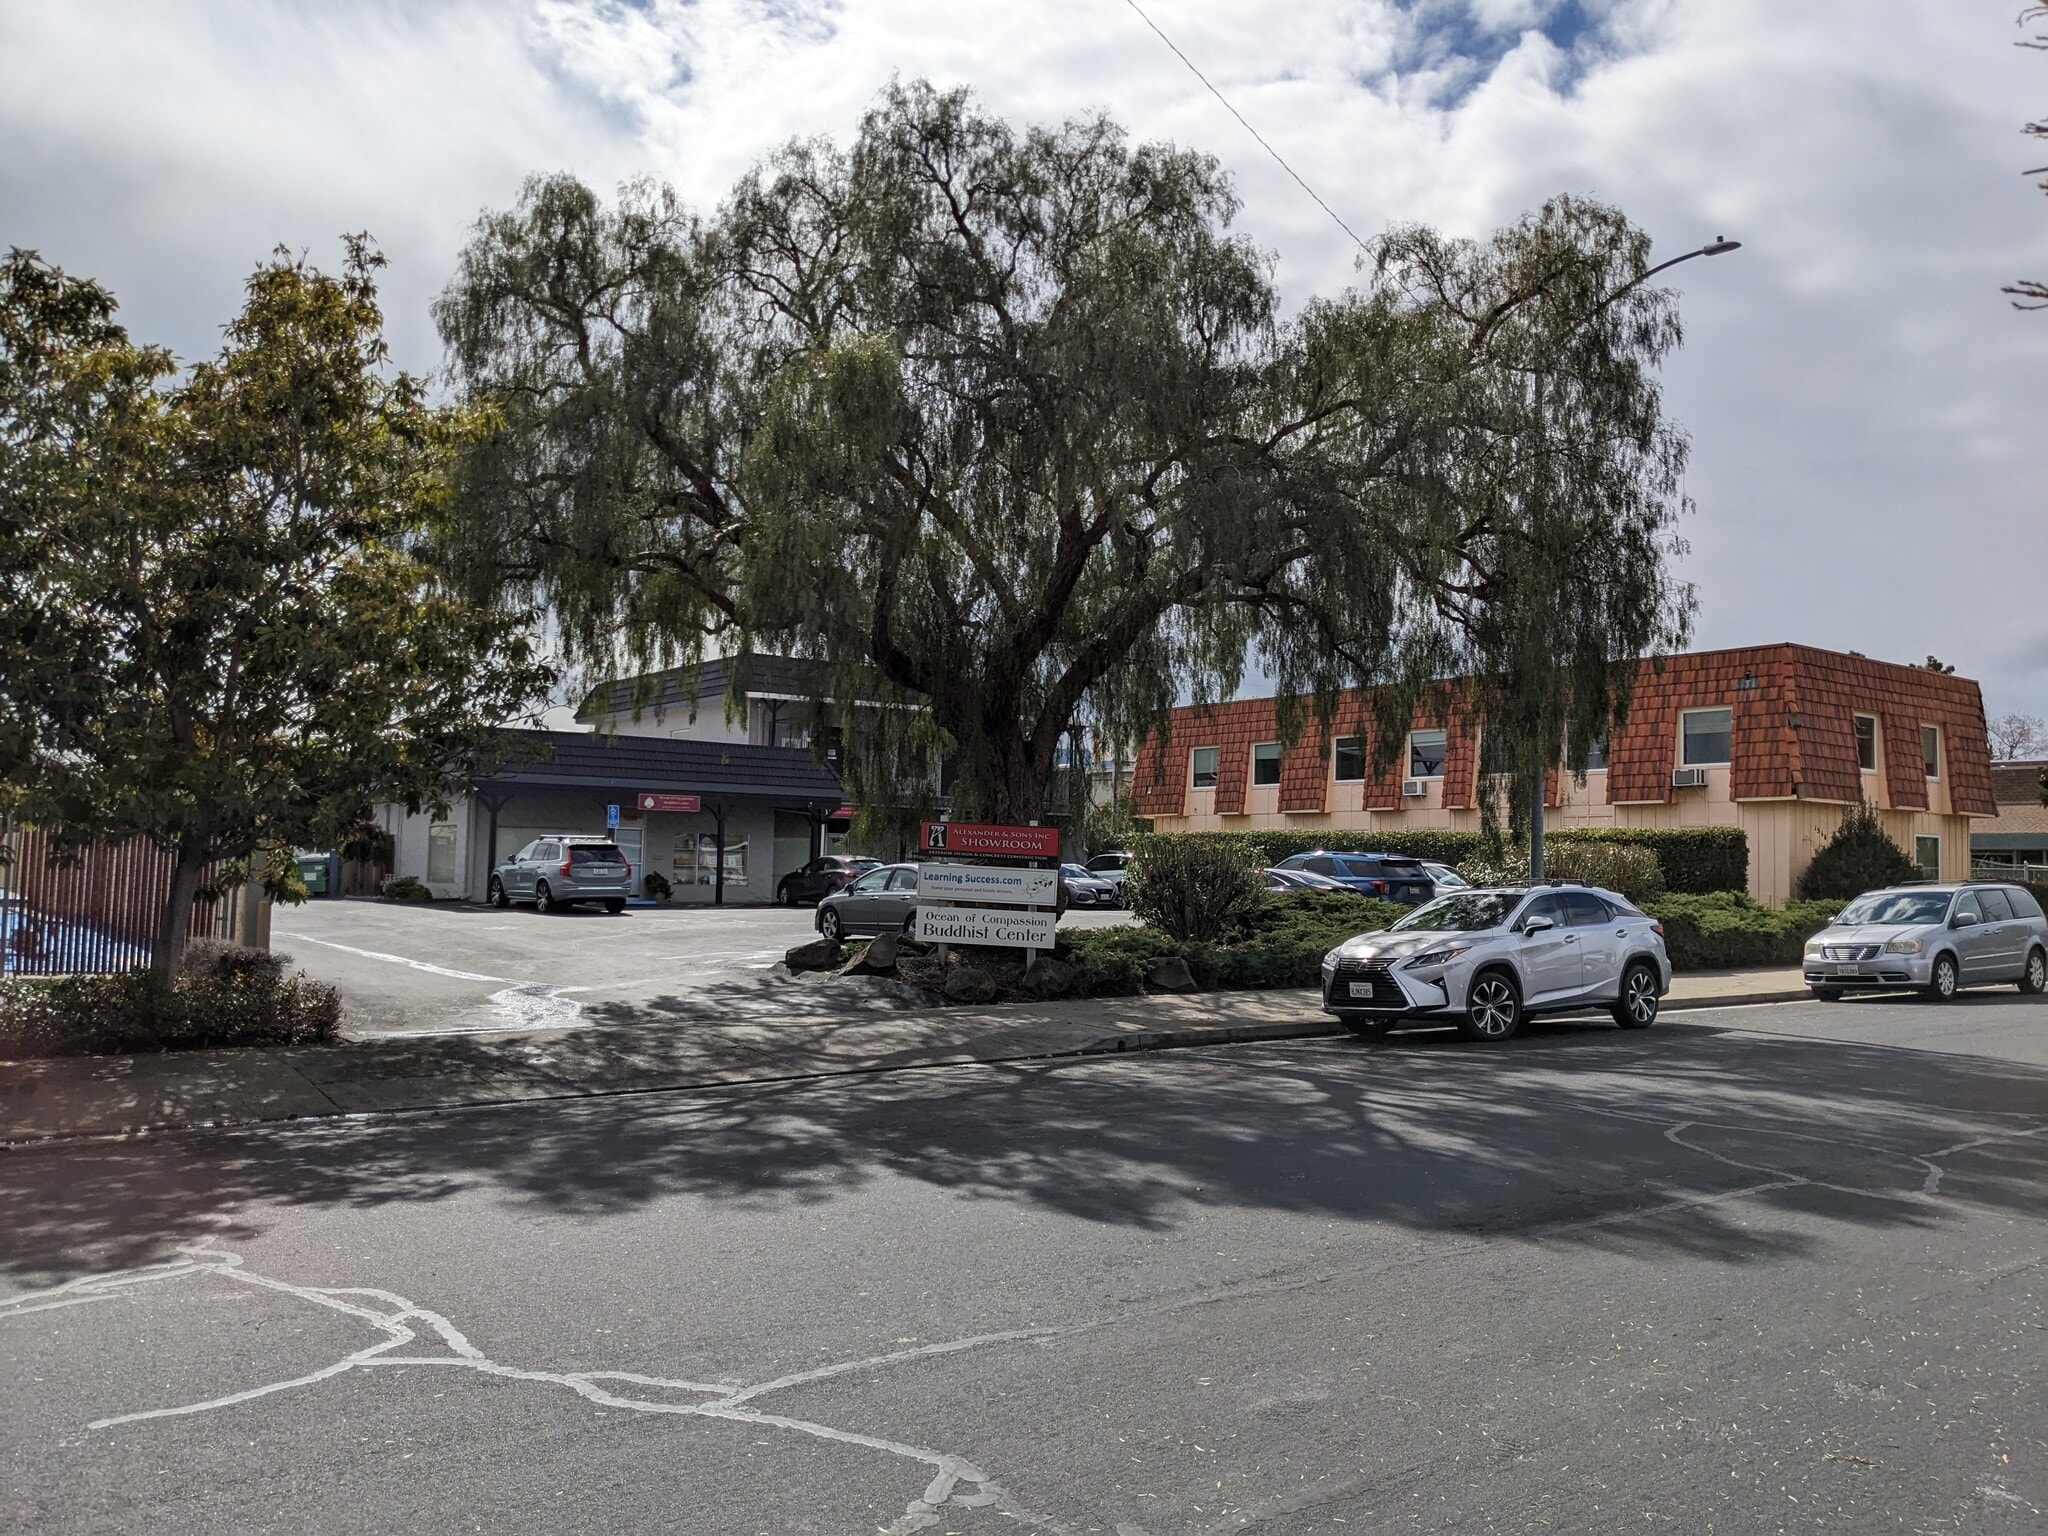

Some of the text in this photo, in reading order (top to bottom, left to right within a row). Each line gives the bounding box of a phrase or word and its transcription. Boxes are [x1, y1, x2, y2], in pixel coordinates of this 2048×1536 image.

[953, 828, 999, 837] ALEXANDER
[1011, 831, 1032, 839] SONS
[961, 837, 1042, 850] SHOWROOM
[924, 871, 1022, 886] Learning Success.com
[926, 911, 1047, 927] Ocean of Compassion
[923, 923, 1046, 942] Buddhist Center
